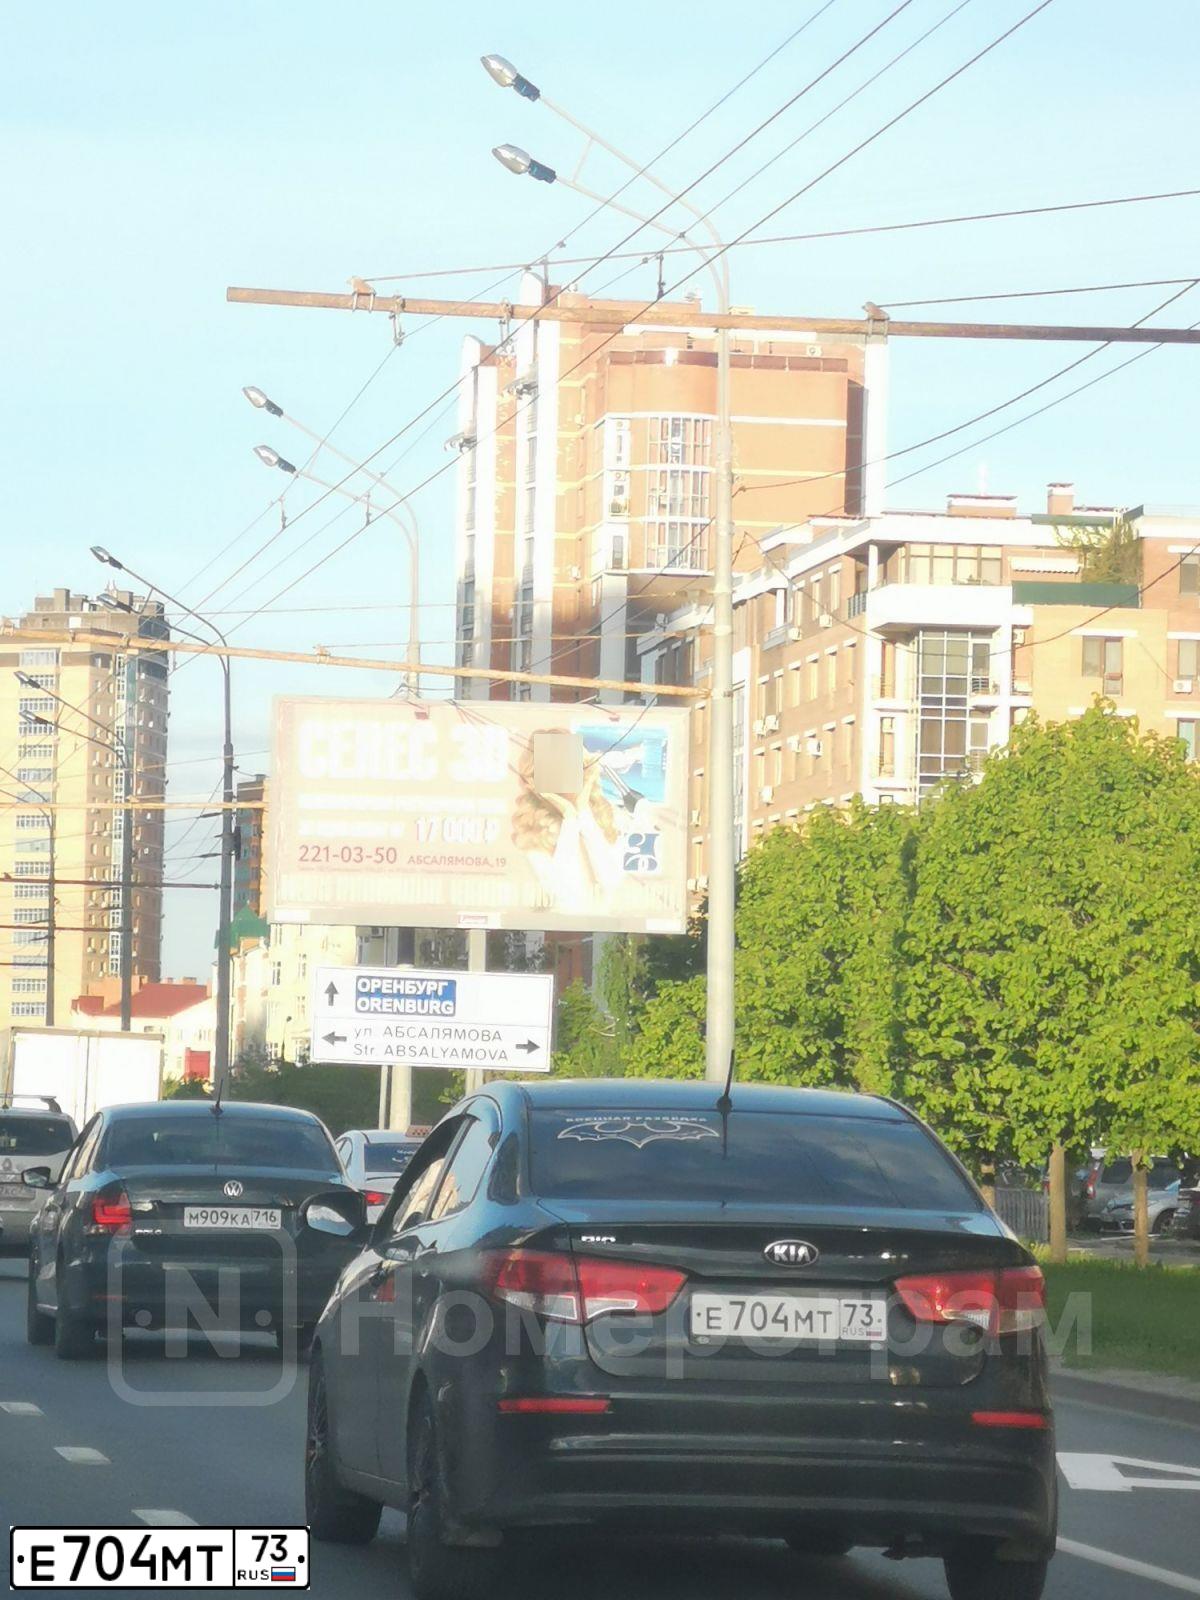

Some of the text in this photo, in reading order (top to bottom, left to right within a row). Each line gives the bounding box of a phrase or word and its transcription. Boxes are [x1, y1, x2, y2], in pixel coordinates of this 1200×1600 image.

[299, 845, 397, 865] 221-03-50
[357, 977, 448, 996] ОРЕНБУРГ
[356, 997, 454, 1015] ORENBURG
[383, 1026, 503, 1042] АБСАЛЯМОВА
[384, 1044, 509, 1061] ABSALYAMOVA
[188, 1210, 277, 1226] М909КА 716
[773, 1245, 812, 1263] KIA
[706, 1301, 873, 1333] Е704МТ 73
[842, 1327, 865, 1336] RUS
